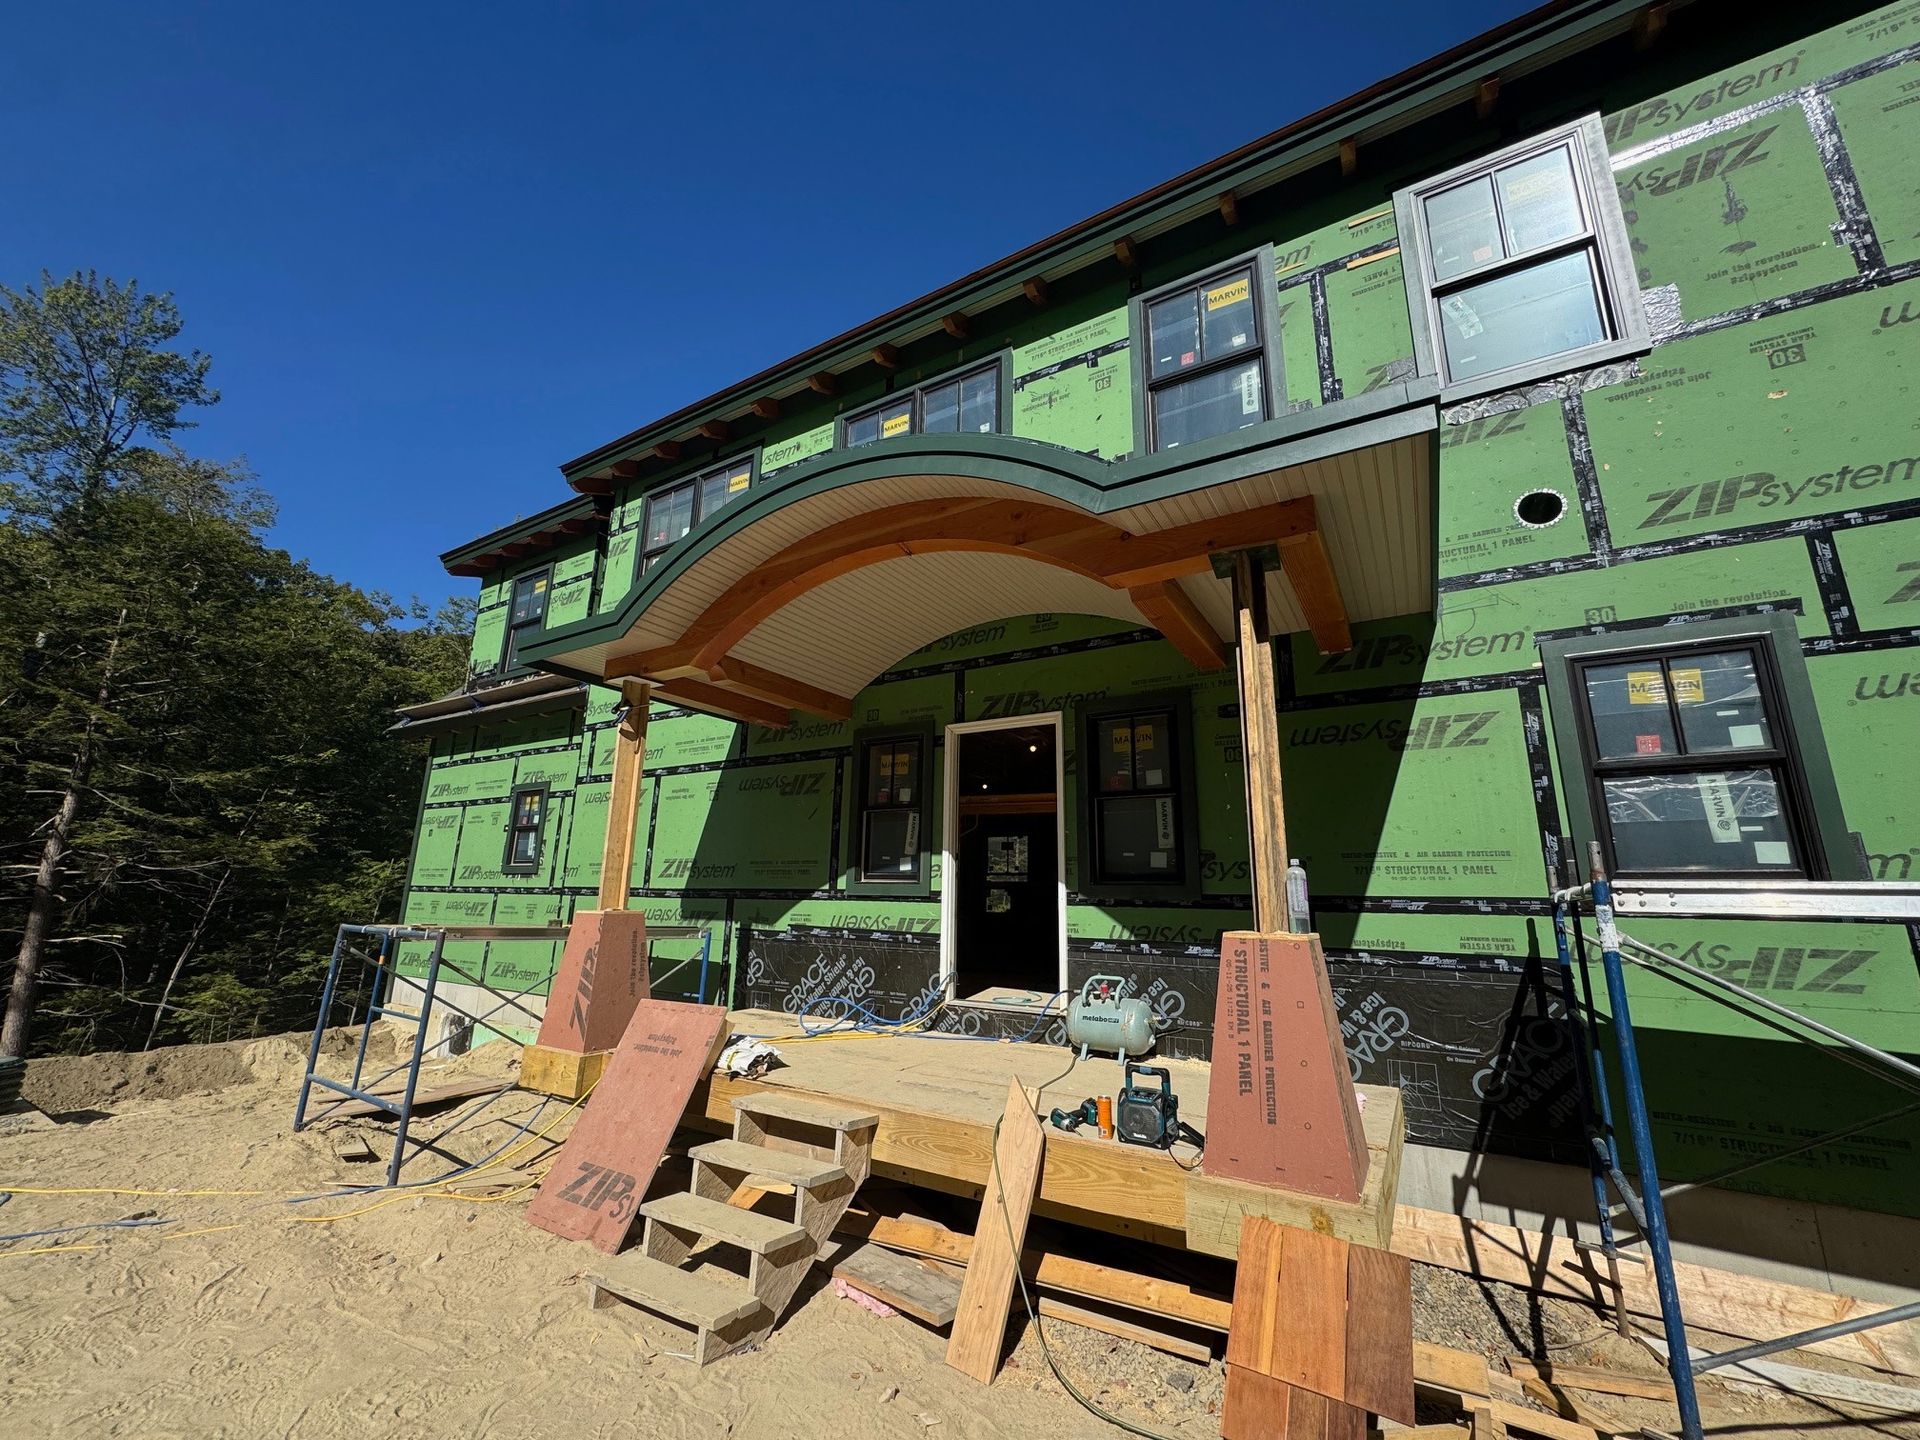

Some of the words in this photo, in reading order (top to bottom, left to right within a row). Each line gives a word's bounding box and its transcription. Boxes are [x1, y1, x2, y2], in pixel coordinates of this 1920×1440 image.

[1603, 57, 1801, 146] IPsystem
[1704, 269, 1728, 281] Join
[1731, 262, 1751, 275] the
[1208, 286, 1247, 304] MARVIN
[1750, 340, 1788, 354] SYSTEM
[1790, 332, 1818, 345] YEAR
[1770, 345, 1804, 367] 30
[1687, 371, 1712, 383] Join
[762, 442, 802, 467] ystem
[1439, 543, 1490, 559] RUCTURAL
[1502, 535, 1536, 548] PANEL
[1670, 600, 1694, 612] Join
[1699, 596, 1719, 608] the
[1723, 589, 1792, 606] revolution.
[1586, 606, 1615, 624] 30
[1290, 711, 1500, 752] ZIPsystem
[738, 772, 826, 796] ZIPsystem
[1161, 801, 1169, 831] MARVIN
[908, 814, 917, 842] MARVIN
[1466, 850, 1511, 858] PROTECTION
[658, 858, 735, 878] ZIPsystem
[1385, 865, 1449, 876] STRUCTURAL
[1453, 865, 1459, 876] 1
[1462, 865, 1498, 876] PANEL
[1109, 925, 1203, 942] system
[1460, 942, 1492, 950] SYSTEM
[1495, 943, 1516, 951] YEAR
[401, 952, 434, 969] ZIPsyste
[491, 960, 540, 982] ZIPsystem
[852, 957, 866, 971] Ice
[783, 953, 831, 1015] GRACE
[806, 981, 826, 1002] Water
[824, 957, 846, 985] Shield
[1148, 977, 1169, 996] Ice
[1261, 982, 1271, 990] &
[900, 972, 940, 1021] GRAC
[1234, 949, 1250, 1035] STRUCTURAL
[1361, 991, 1387, 1014] Ice
[812, 999, 831, 1016] Shie
[1262, 999, 1272, 1016] AIR
[1349, 1009, 1367, 1025] &
[1082, 1015, 1108, 1023] metabo
[1263, 1019, 1274, 1062] BARRIER
[1345, 1006, 1410, 1082] GRA
[1238, 1052, 1252, 1097] PANEL
[1265, 1067, 1277, 1125] PROTECTION
[1501, 1096, 1530, 1121] Ice
[1522, 1082, 1544, 1101] &
[1719, 1137, 1814, 1161] STRUCTL
[1838, 1153, 1891, 1170] PANEL
